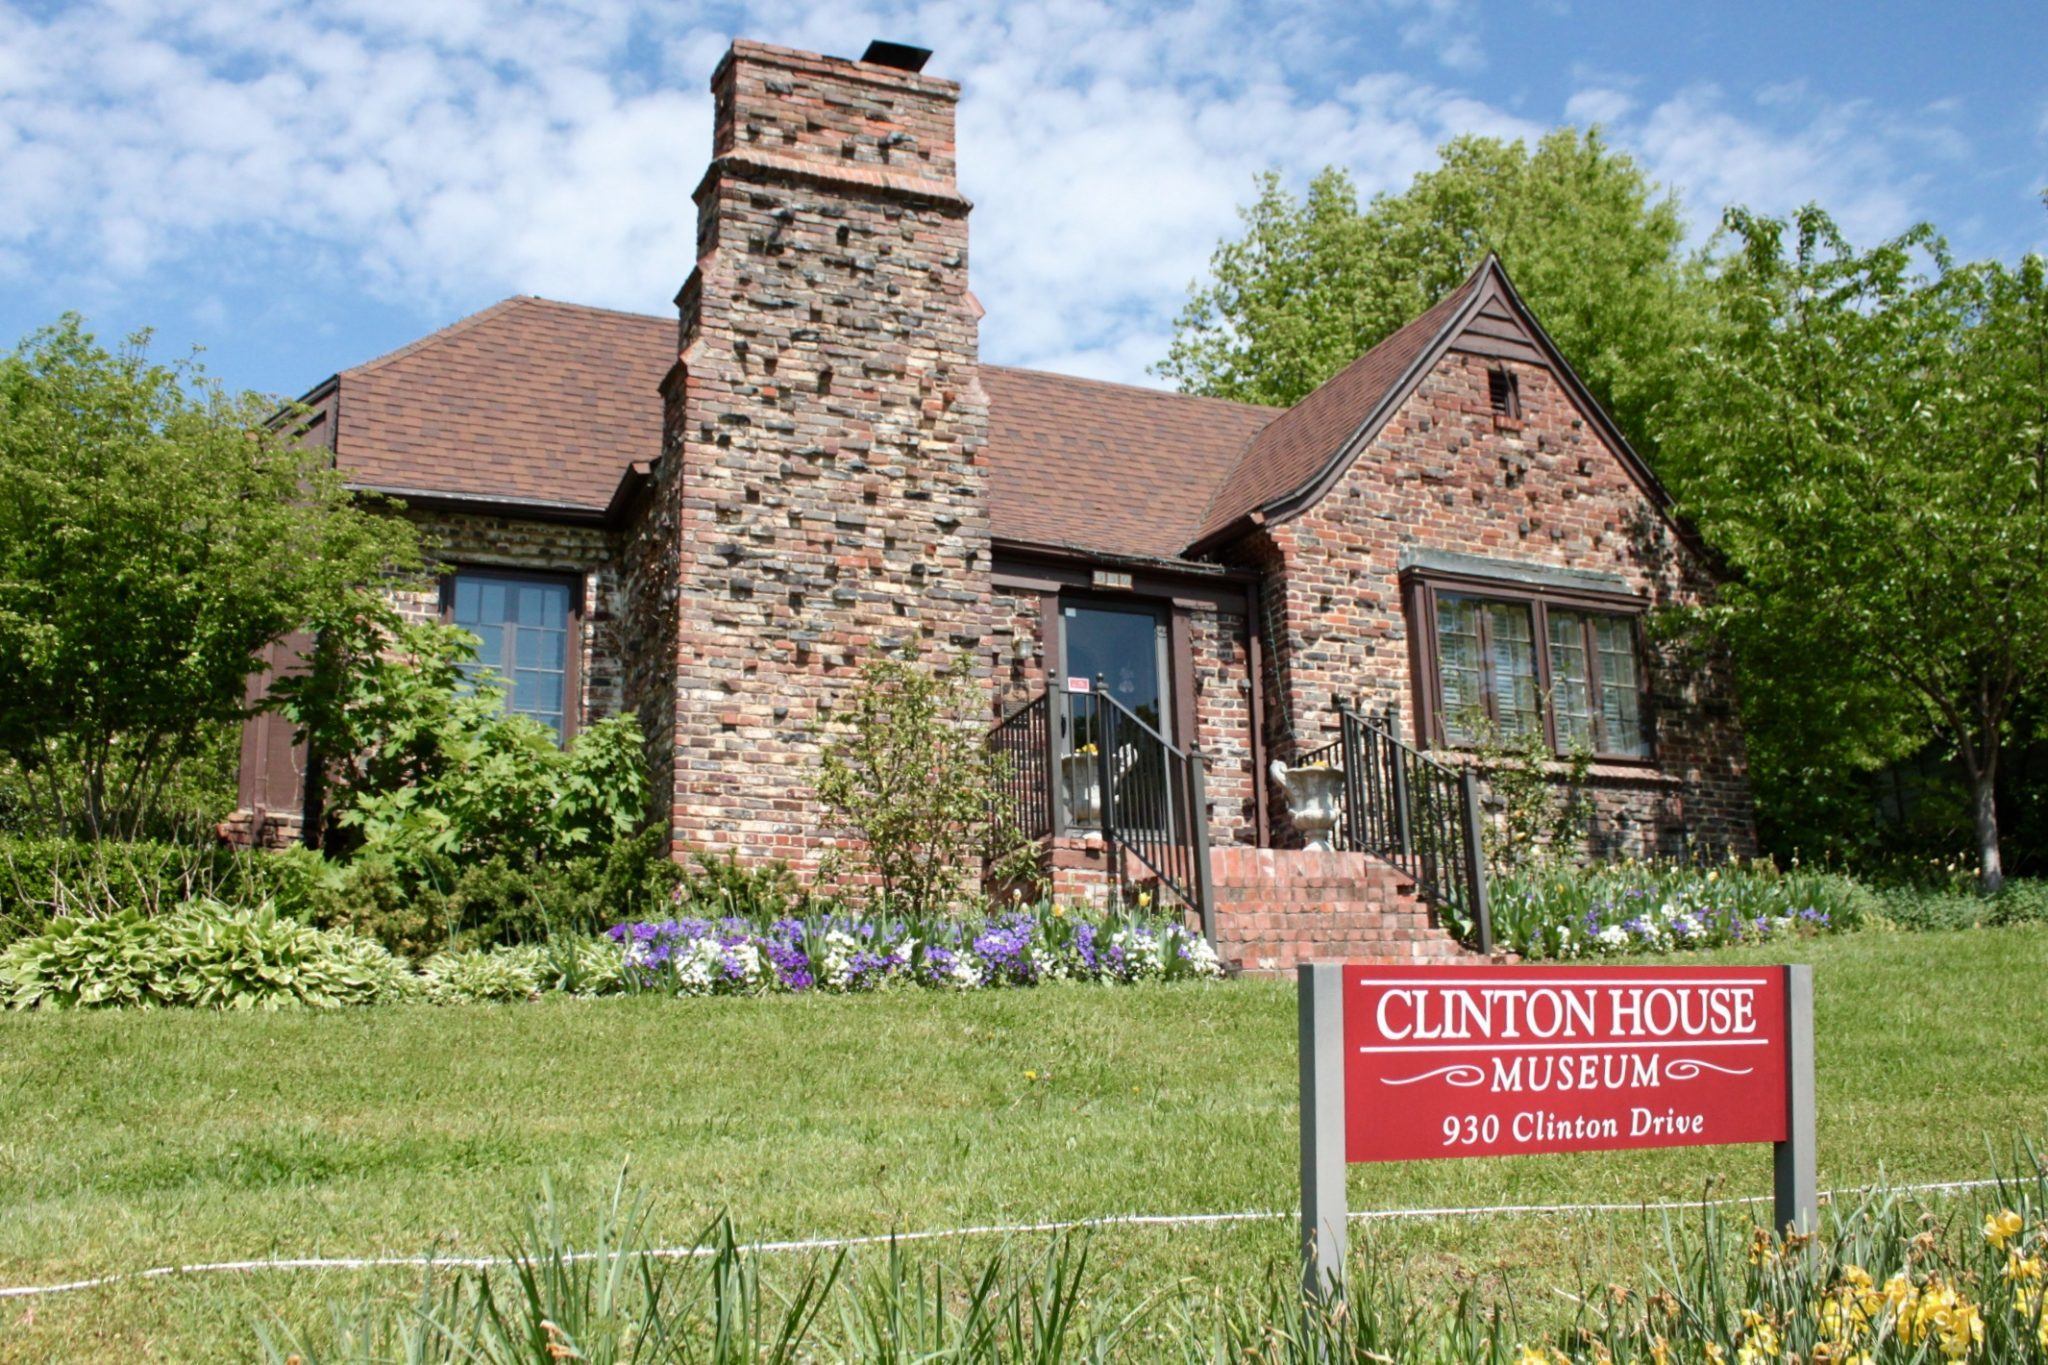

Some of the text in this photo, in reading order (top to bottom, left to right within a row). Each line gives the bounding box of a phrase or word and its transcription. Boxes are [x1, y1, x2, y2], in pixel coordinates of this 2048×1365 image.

[1376, 987, 1757, 1039] CLINTON HOUSE
[1490, 1054, 1660, 1092] MUSEUM
[1442, 1107, 1704, 1145] 930 Clinton Drive
